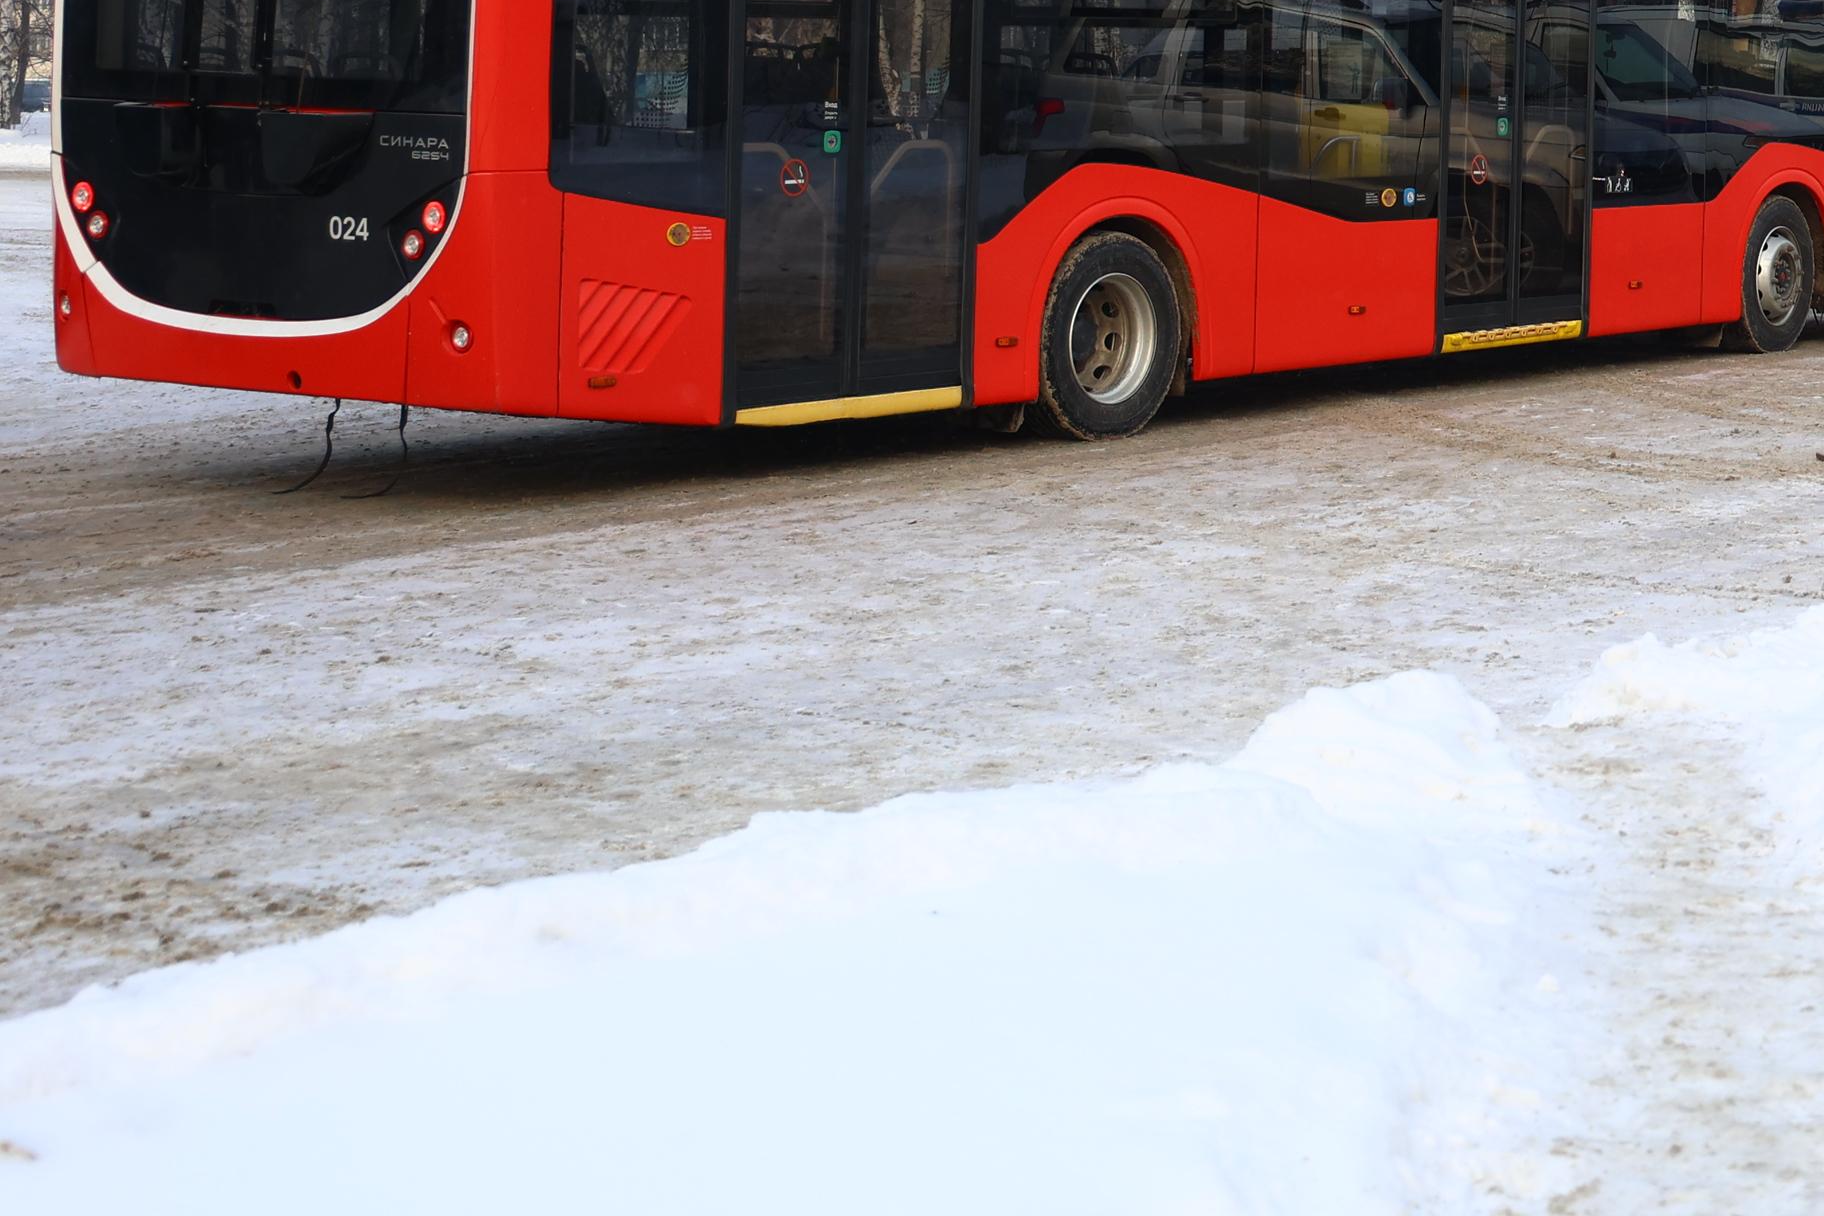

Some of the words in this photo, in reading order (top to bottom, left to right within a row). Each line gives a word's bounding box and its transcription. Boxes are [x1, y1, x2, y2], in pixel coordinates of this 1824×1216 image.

[379, 135, 449, 149] СИНАРА
[411, 150, 449, 161] 6254
[329, 215, 369, 241] 024
